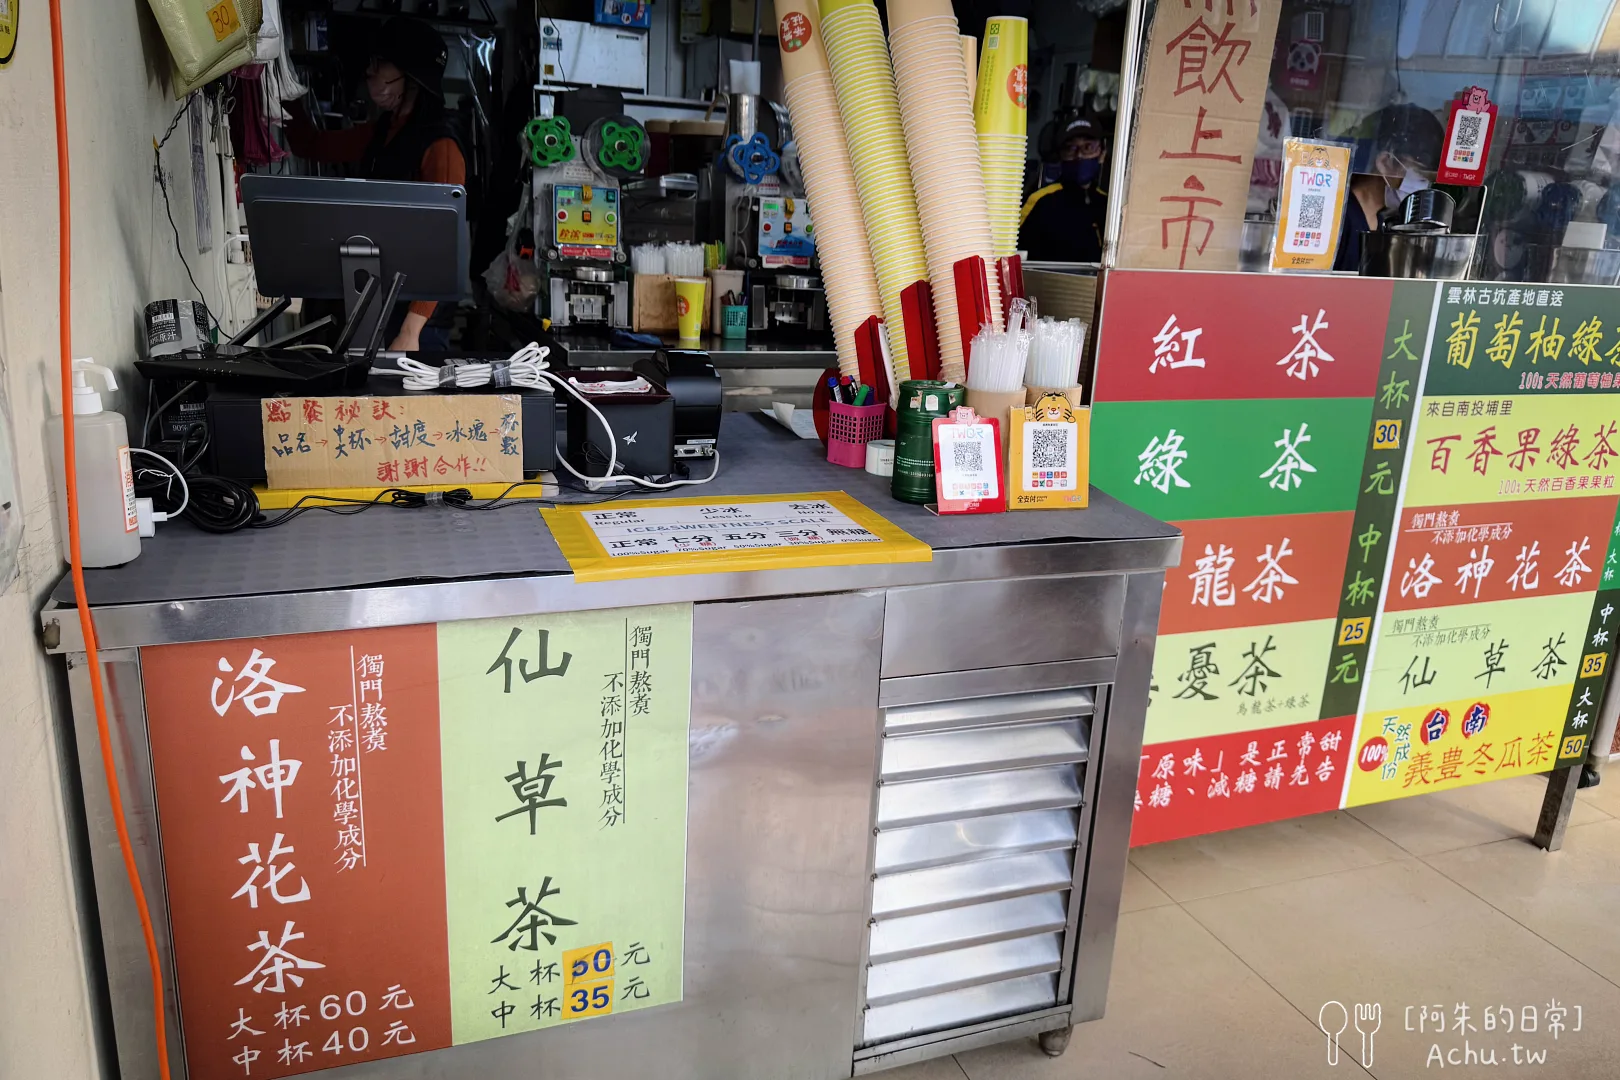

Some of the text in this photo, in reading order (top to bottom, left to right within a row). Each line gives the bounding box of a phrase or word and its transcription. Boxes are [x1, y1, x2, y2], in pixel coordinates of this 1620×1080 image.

[211, 5, 231, 36] 30
[1159, 0, 1258, 268] 飲上市
[1300, 171, 1333, 188] TWQR
[1447, 286, 1565, 307] 雲林古坑產地直送
[1426, 399, 1513, 417] 來自南投埔里
[389, 418, 436, 450] 甜度
[445, 418, 488, 443] 冰塊
[1426, 420, 1619, 476] 百香果綠茶
[591, 511, 637, 520] 正常
[699, 506, 742, 515] 少冰
[594, 518, 646, 526] Regular
[777, 517, 831, 526] SCALE
[608, 538, 658, 549] 正常
[667, 534, 714, 544] 七分
[722, 531, 767, 541] 五分
[775, 529, 819, 539] 三分
[1431, 526, 1514, 545] 不添加化學成分
[1163, 537, 1299, 607] 龍茶
[1400, 536, 1593, 600] 洛神花茶
[1147, 635, 1283, 707] 憂茶
[1398, 631, 1568, 695] 仙草茶
[598, 671, 624, 830] 不添加化學成分
[1361, 745, 1389, 764] 100%
[326, 704, 363, 873] 不添加化學成分
[486, 627, 579, 951] 仙草茶
[211, 648, 327, 994] 洛神花茶
